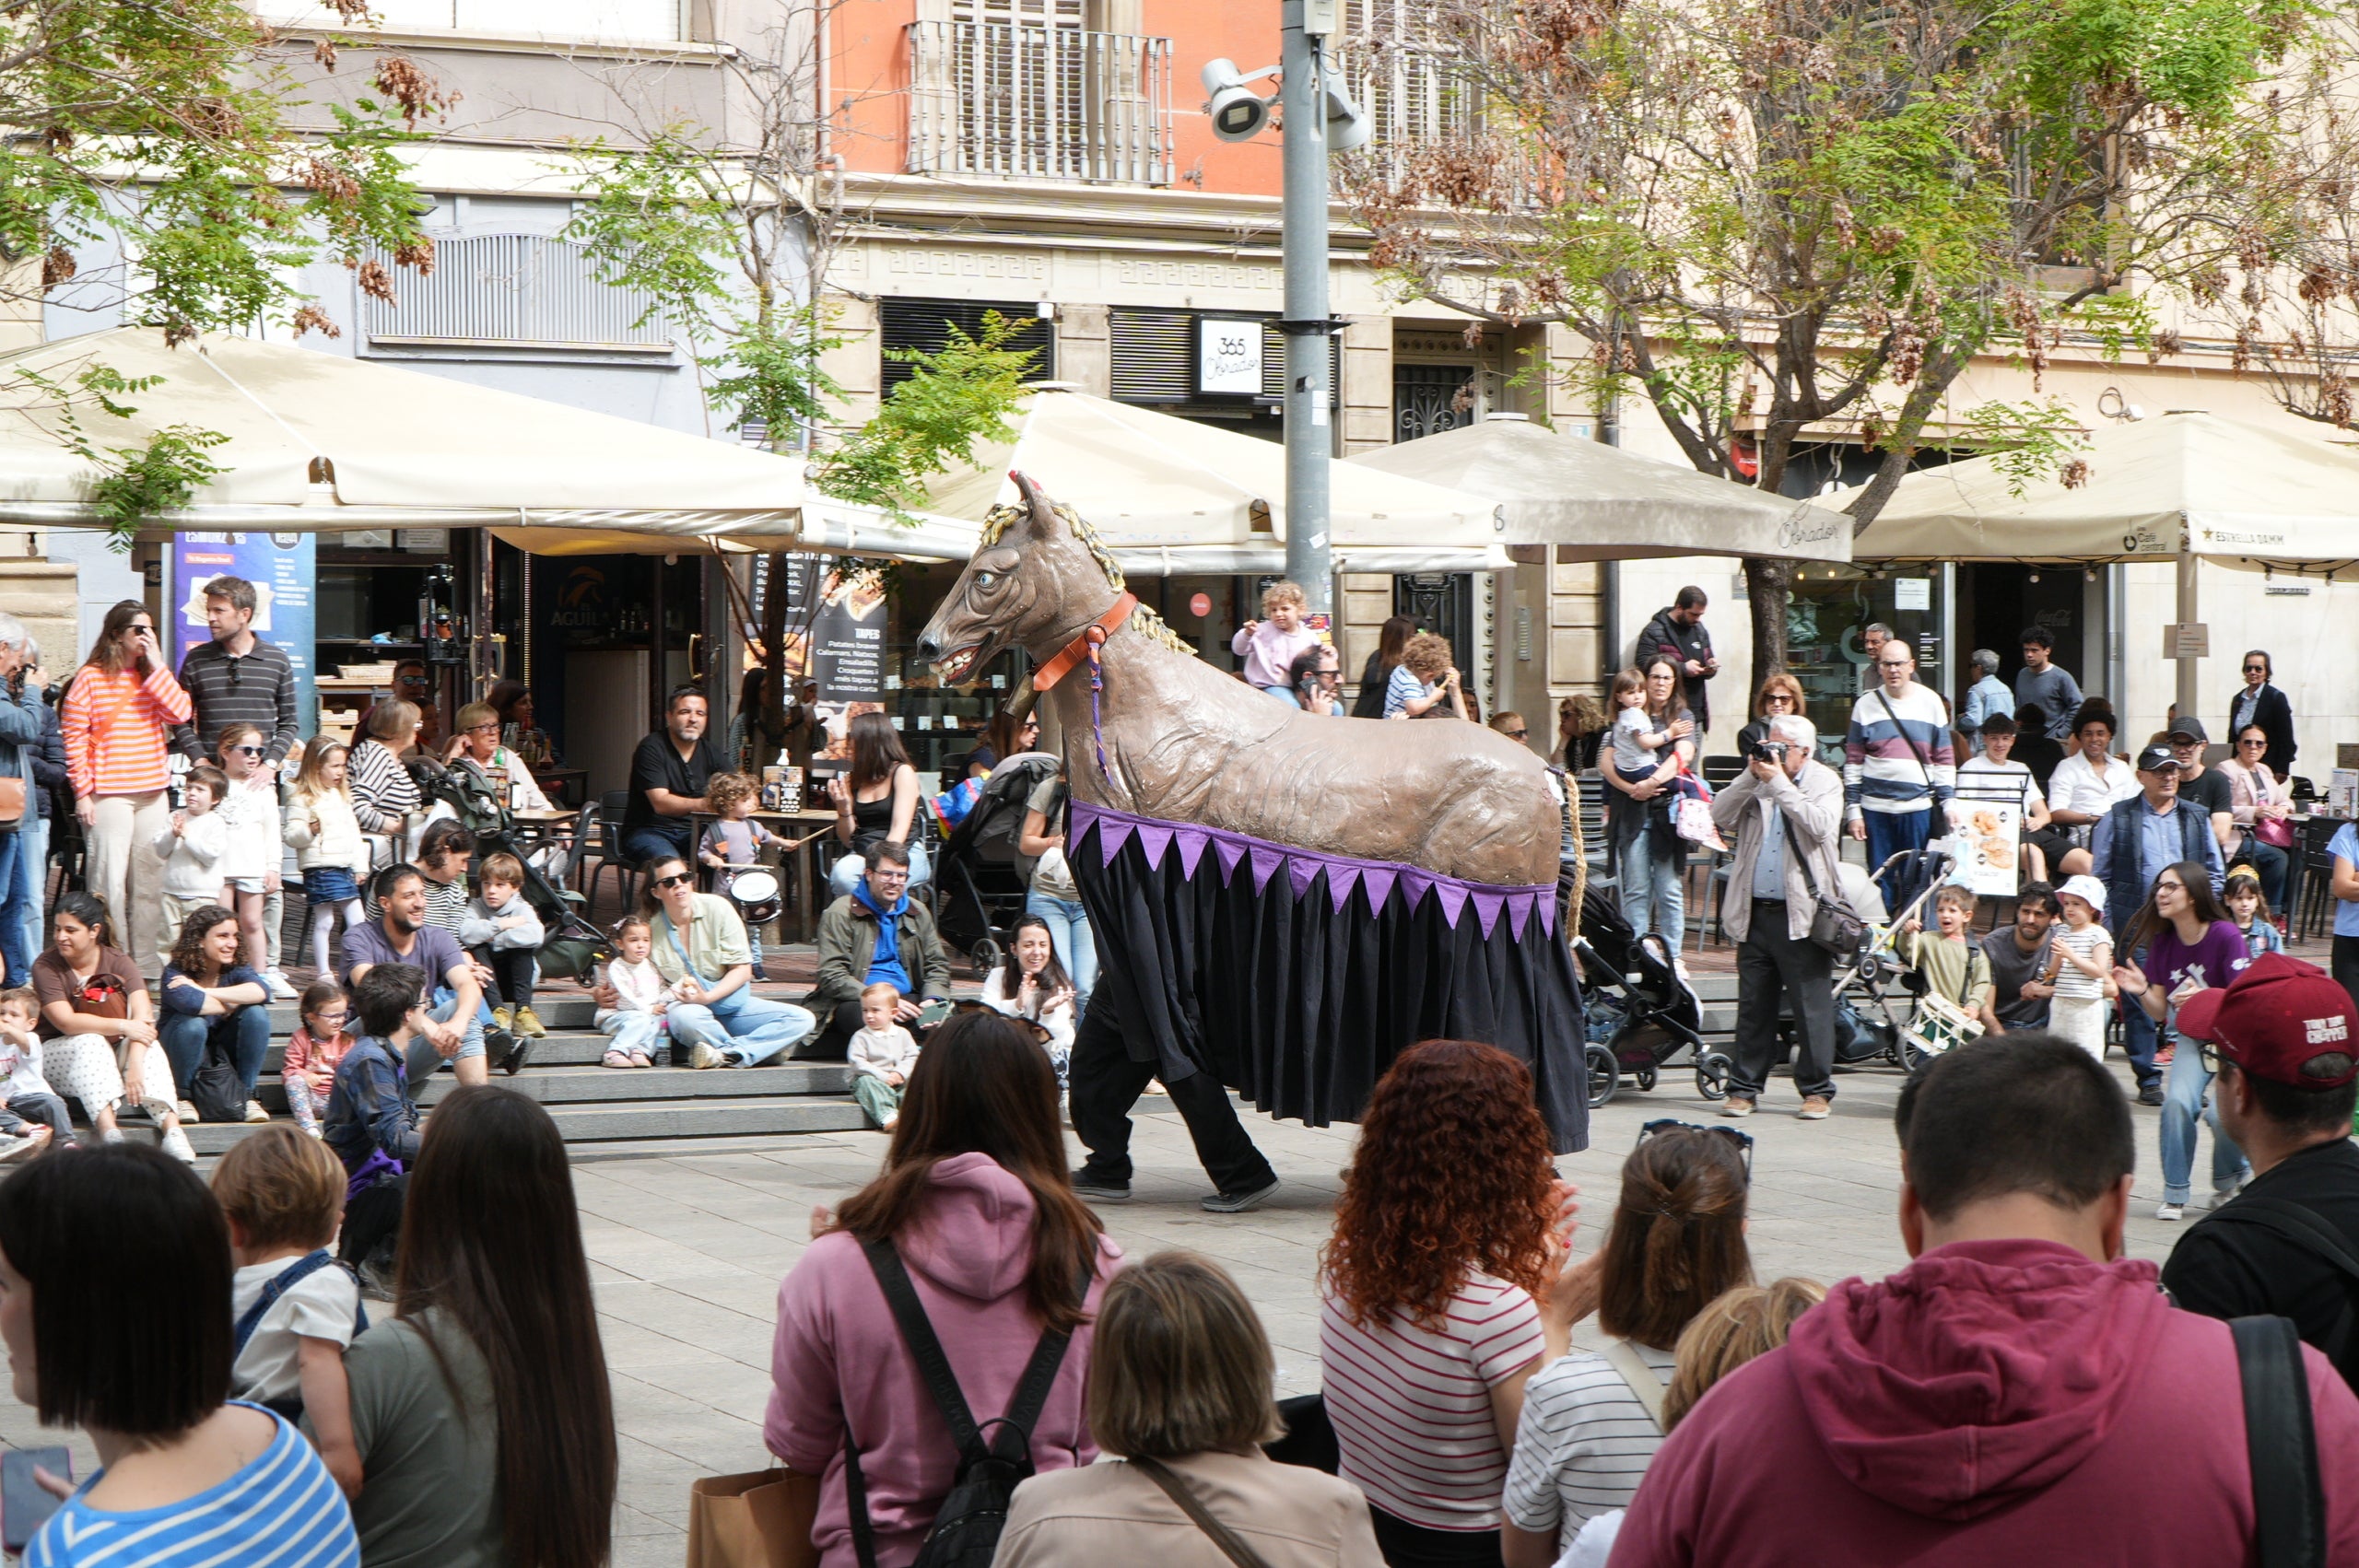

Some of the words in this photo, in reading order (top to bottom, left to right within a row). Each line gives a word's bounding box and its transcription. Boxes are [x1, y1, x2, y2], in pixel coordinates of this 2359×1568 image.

[1217, 337, 1246, 356] 365
[1778, 521, 1838, 549] Obrador
[2216, 532, 2255, 544] ESTRELLA
[2257, 534, 2285, 544] DAMM
